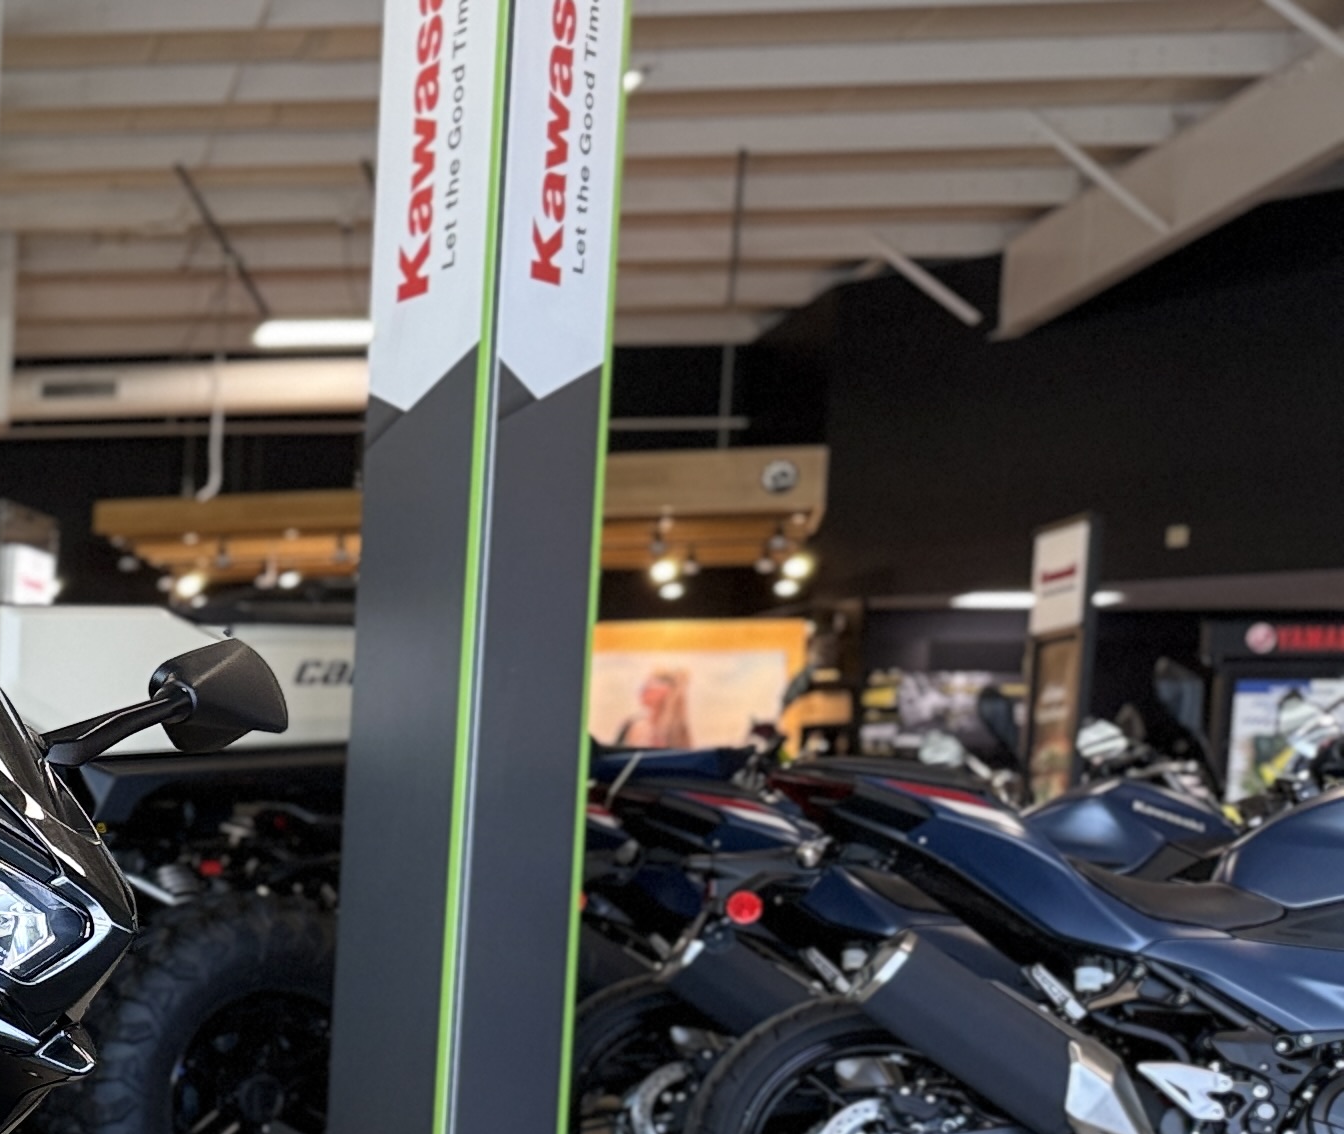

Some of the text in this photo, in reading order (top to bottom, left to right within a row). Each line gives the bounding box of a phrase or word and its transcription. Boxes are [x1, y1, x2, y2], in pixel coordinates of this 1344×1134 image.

[448, 64, 466, 150] Good
[572, 0, 600, 274] Let the Good Tim
[530, 0, 577, 286] Kawas
[445, 159, 460, 209] the
[441, 220, 457, 270] Let
[294, 658, 354, 687] ca
